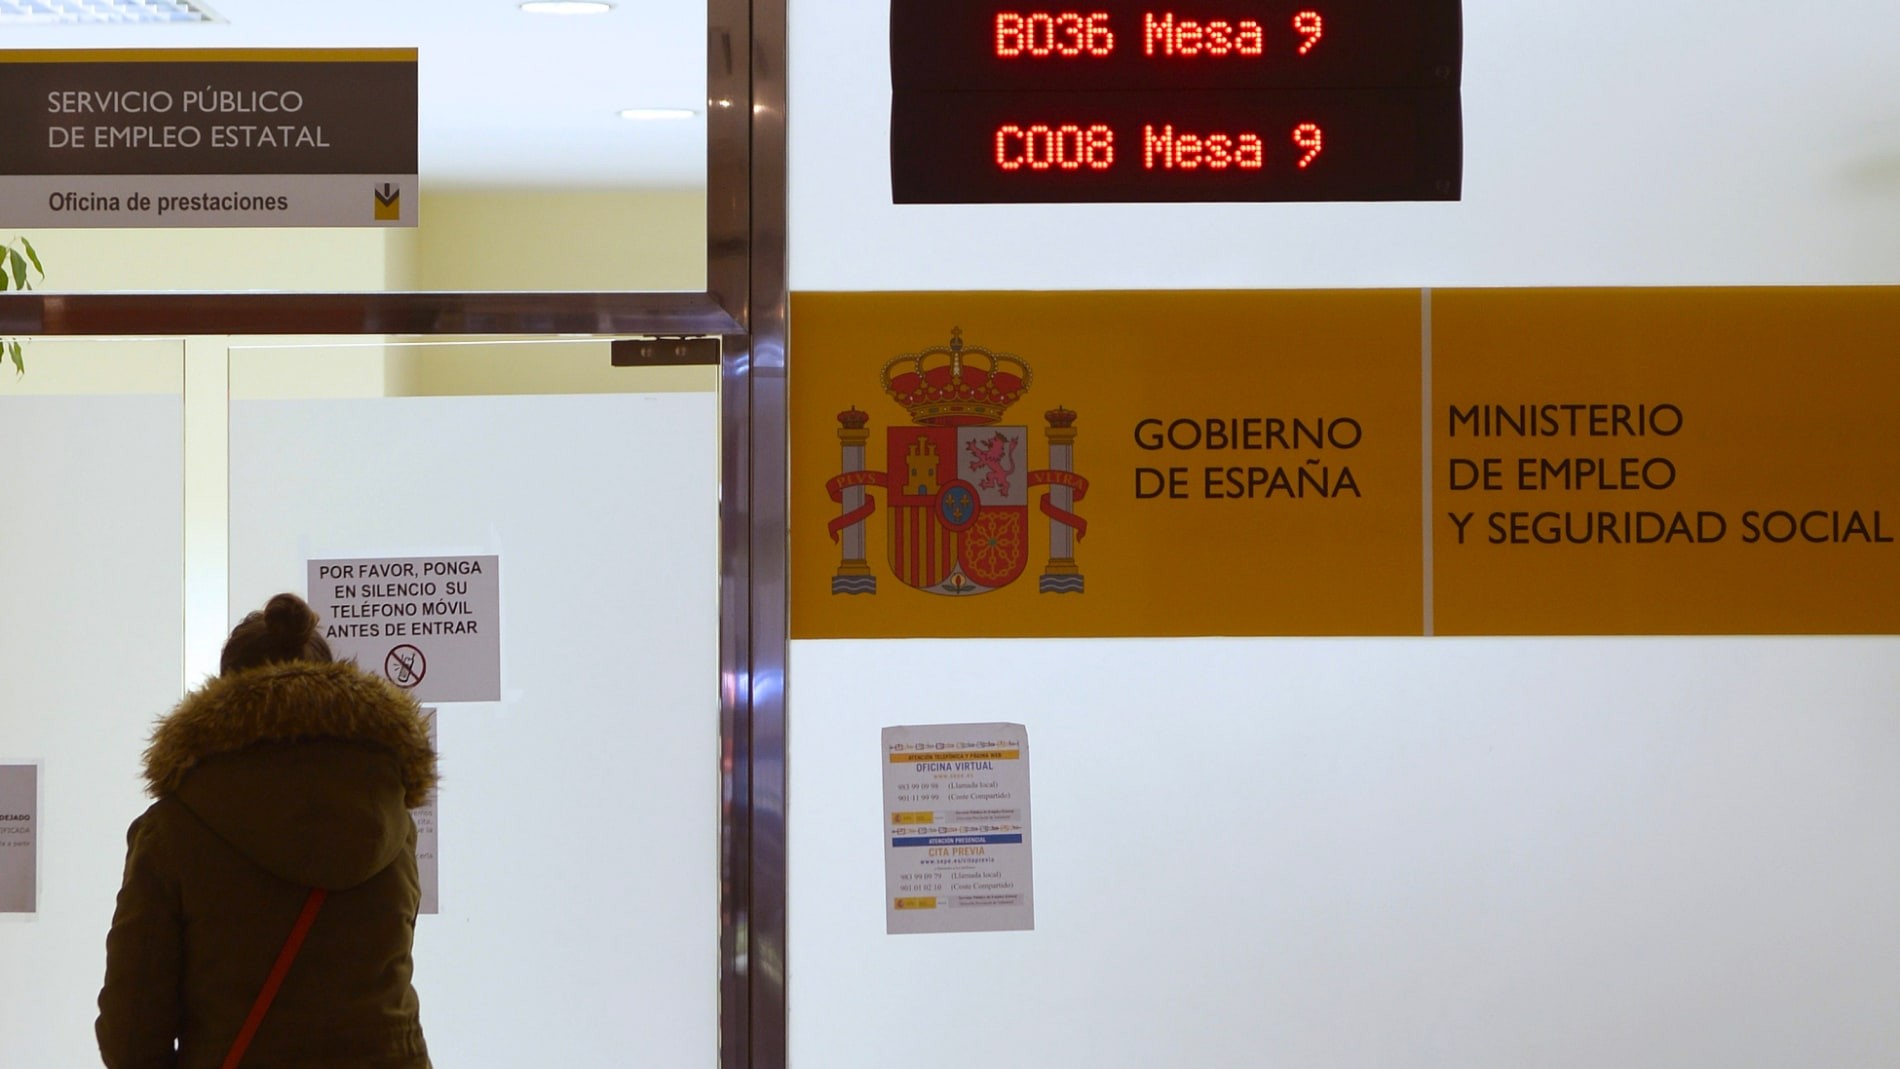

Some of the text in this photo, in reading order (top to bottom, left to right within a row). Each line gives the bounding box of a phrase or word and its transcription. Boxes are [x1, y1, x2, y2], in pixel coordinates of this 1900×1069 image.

[995, 11, 1322, 56] B036 Mesa 9
[48, 85, 303, 114] SERVICIO PÚBLICO
[48, 125, 330, 149] DE EMPLEO ESTATAL
[995, 123, 1322, 169] C008 Mesa 9
[49, 191, 289, 215] Oficina de prestaciones
[1449, 403, 1683, 438] MINISTERIO
[1134, 417, 1362, 451] GOBIERNO
[1135, 459, 1361, 499] DE ESPAÑA
[1449, 457, 1676, 491] DE EMPLEO
[1449, 509, 1894, 545] Y SEGURIDAD SOCIAL
[319, 561, 482, 579] POR FAVOR, PONGA
[335, 581, 467, 598] EN SILENCIO SU
[331, 599, 472, 618] TELÉFONO MÓVIL
[326, 621, 478, 638] ANTES DE ENTRAR
[916, 761, 994, 773] OFICINA VIRTUAL
[928, 846, 985, 857] CITA PREVIA
